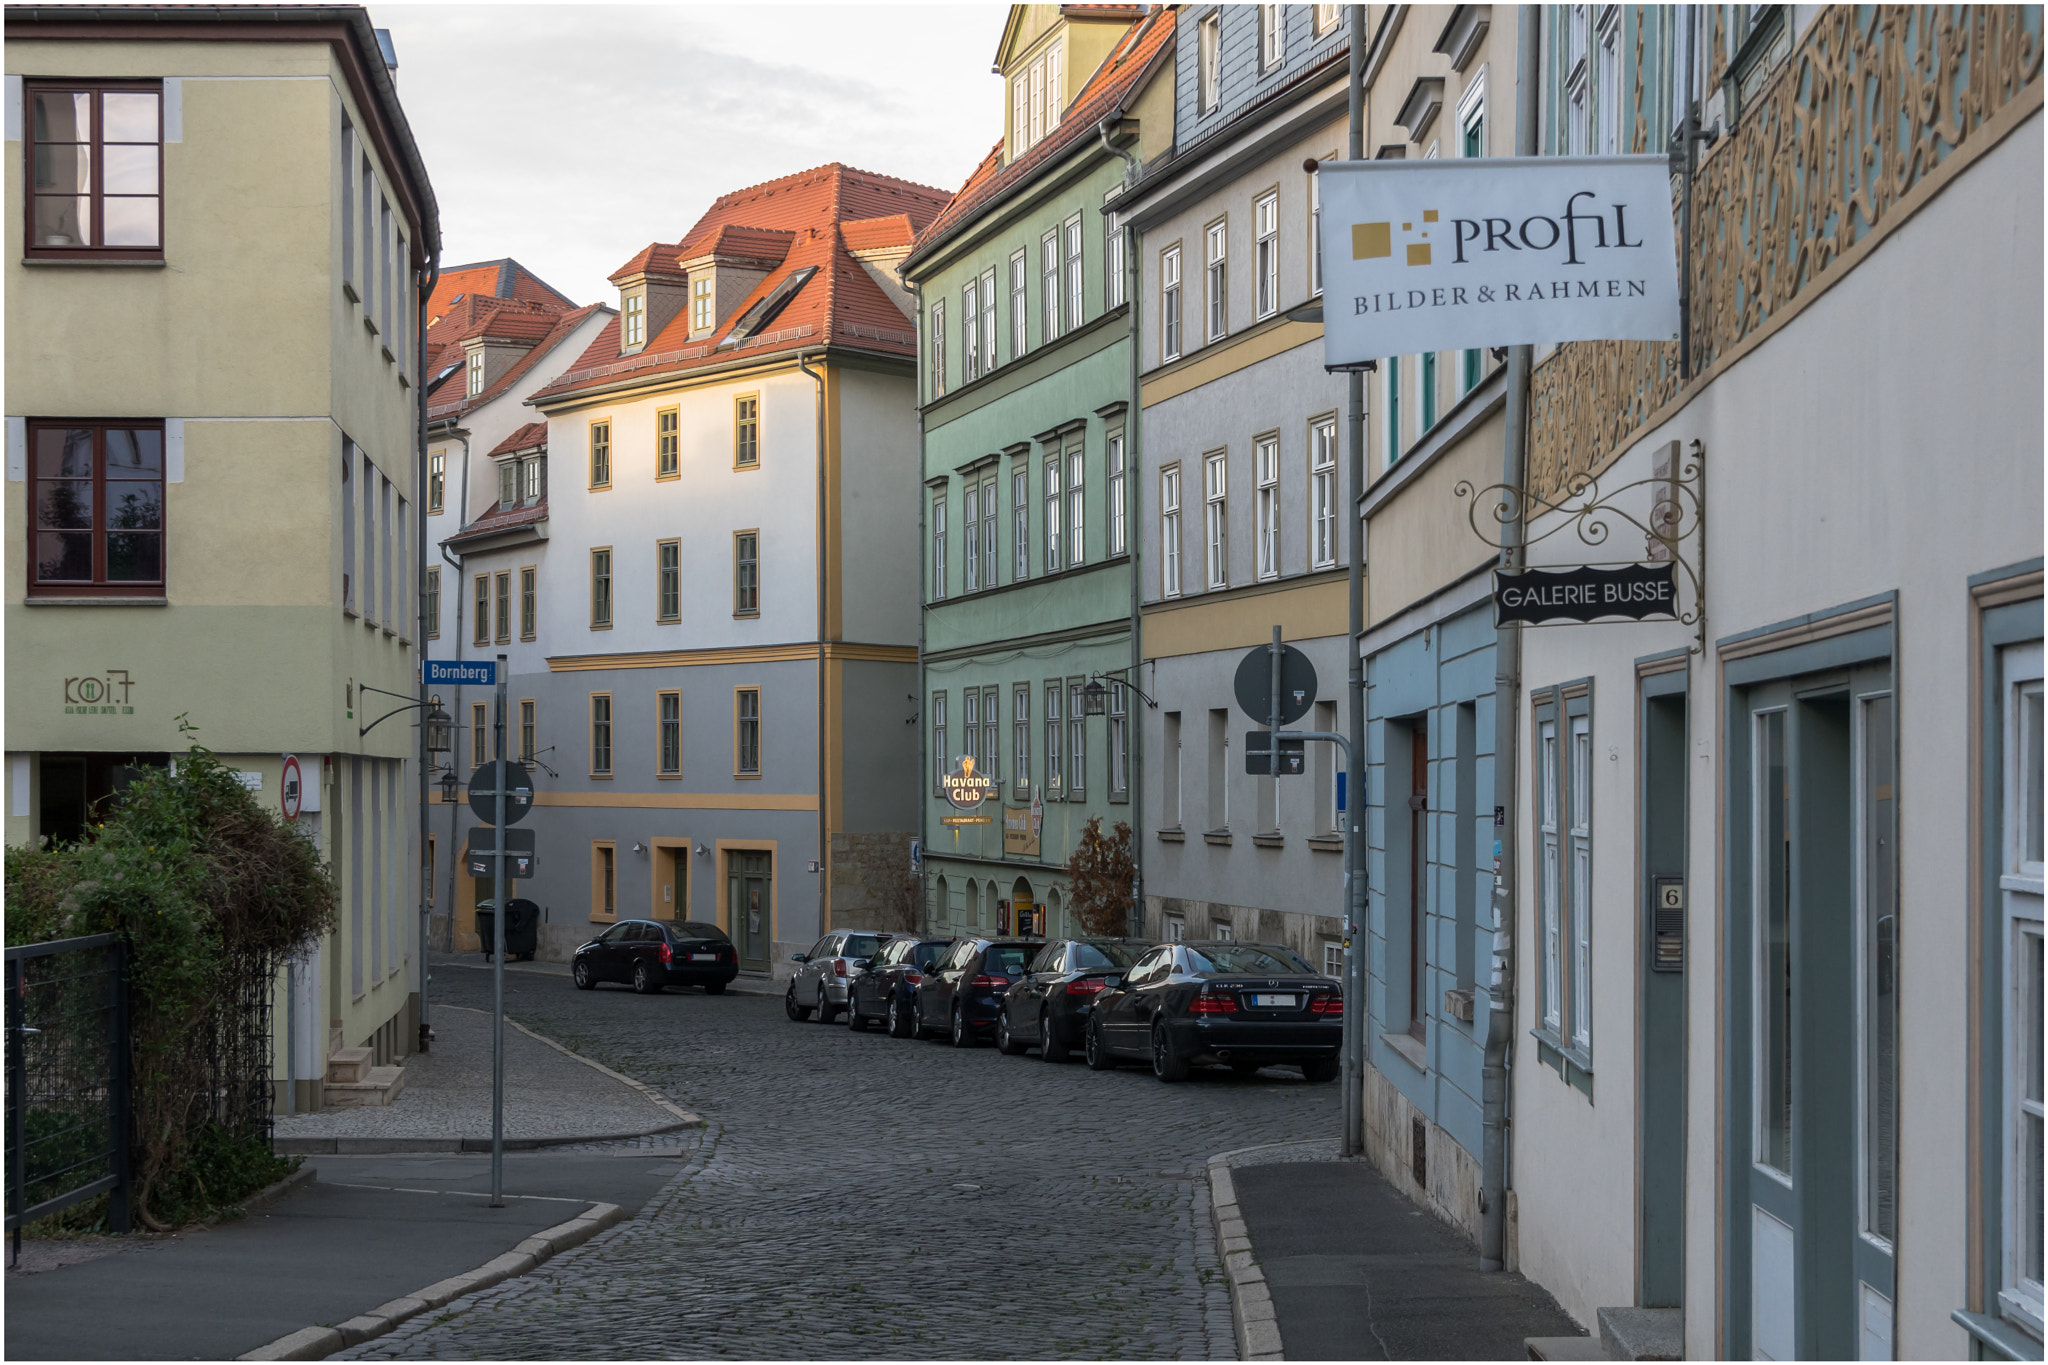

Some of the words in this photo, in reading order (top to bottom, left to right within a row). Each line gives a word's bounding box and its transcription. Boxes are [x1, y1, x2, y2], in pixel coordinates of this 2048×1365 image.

[1353, 286, 1469, 316] BILDER
[1505, 279, 1647, 302] RAHMEN
[1502, 584, 1597, 607] GALERIE
[1604, 581, 1670, 603] BUSSE
[431, 663, 488, 683] Bornberg
[943, 774, 990, 788] Havana
[952, 788, 980, 801] Club
[1665, 889, 1679, 906] 6
